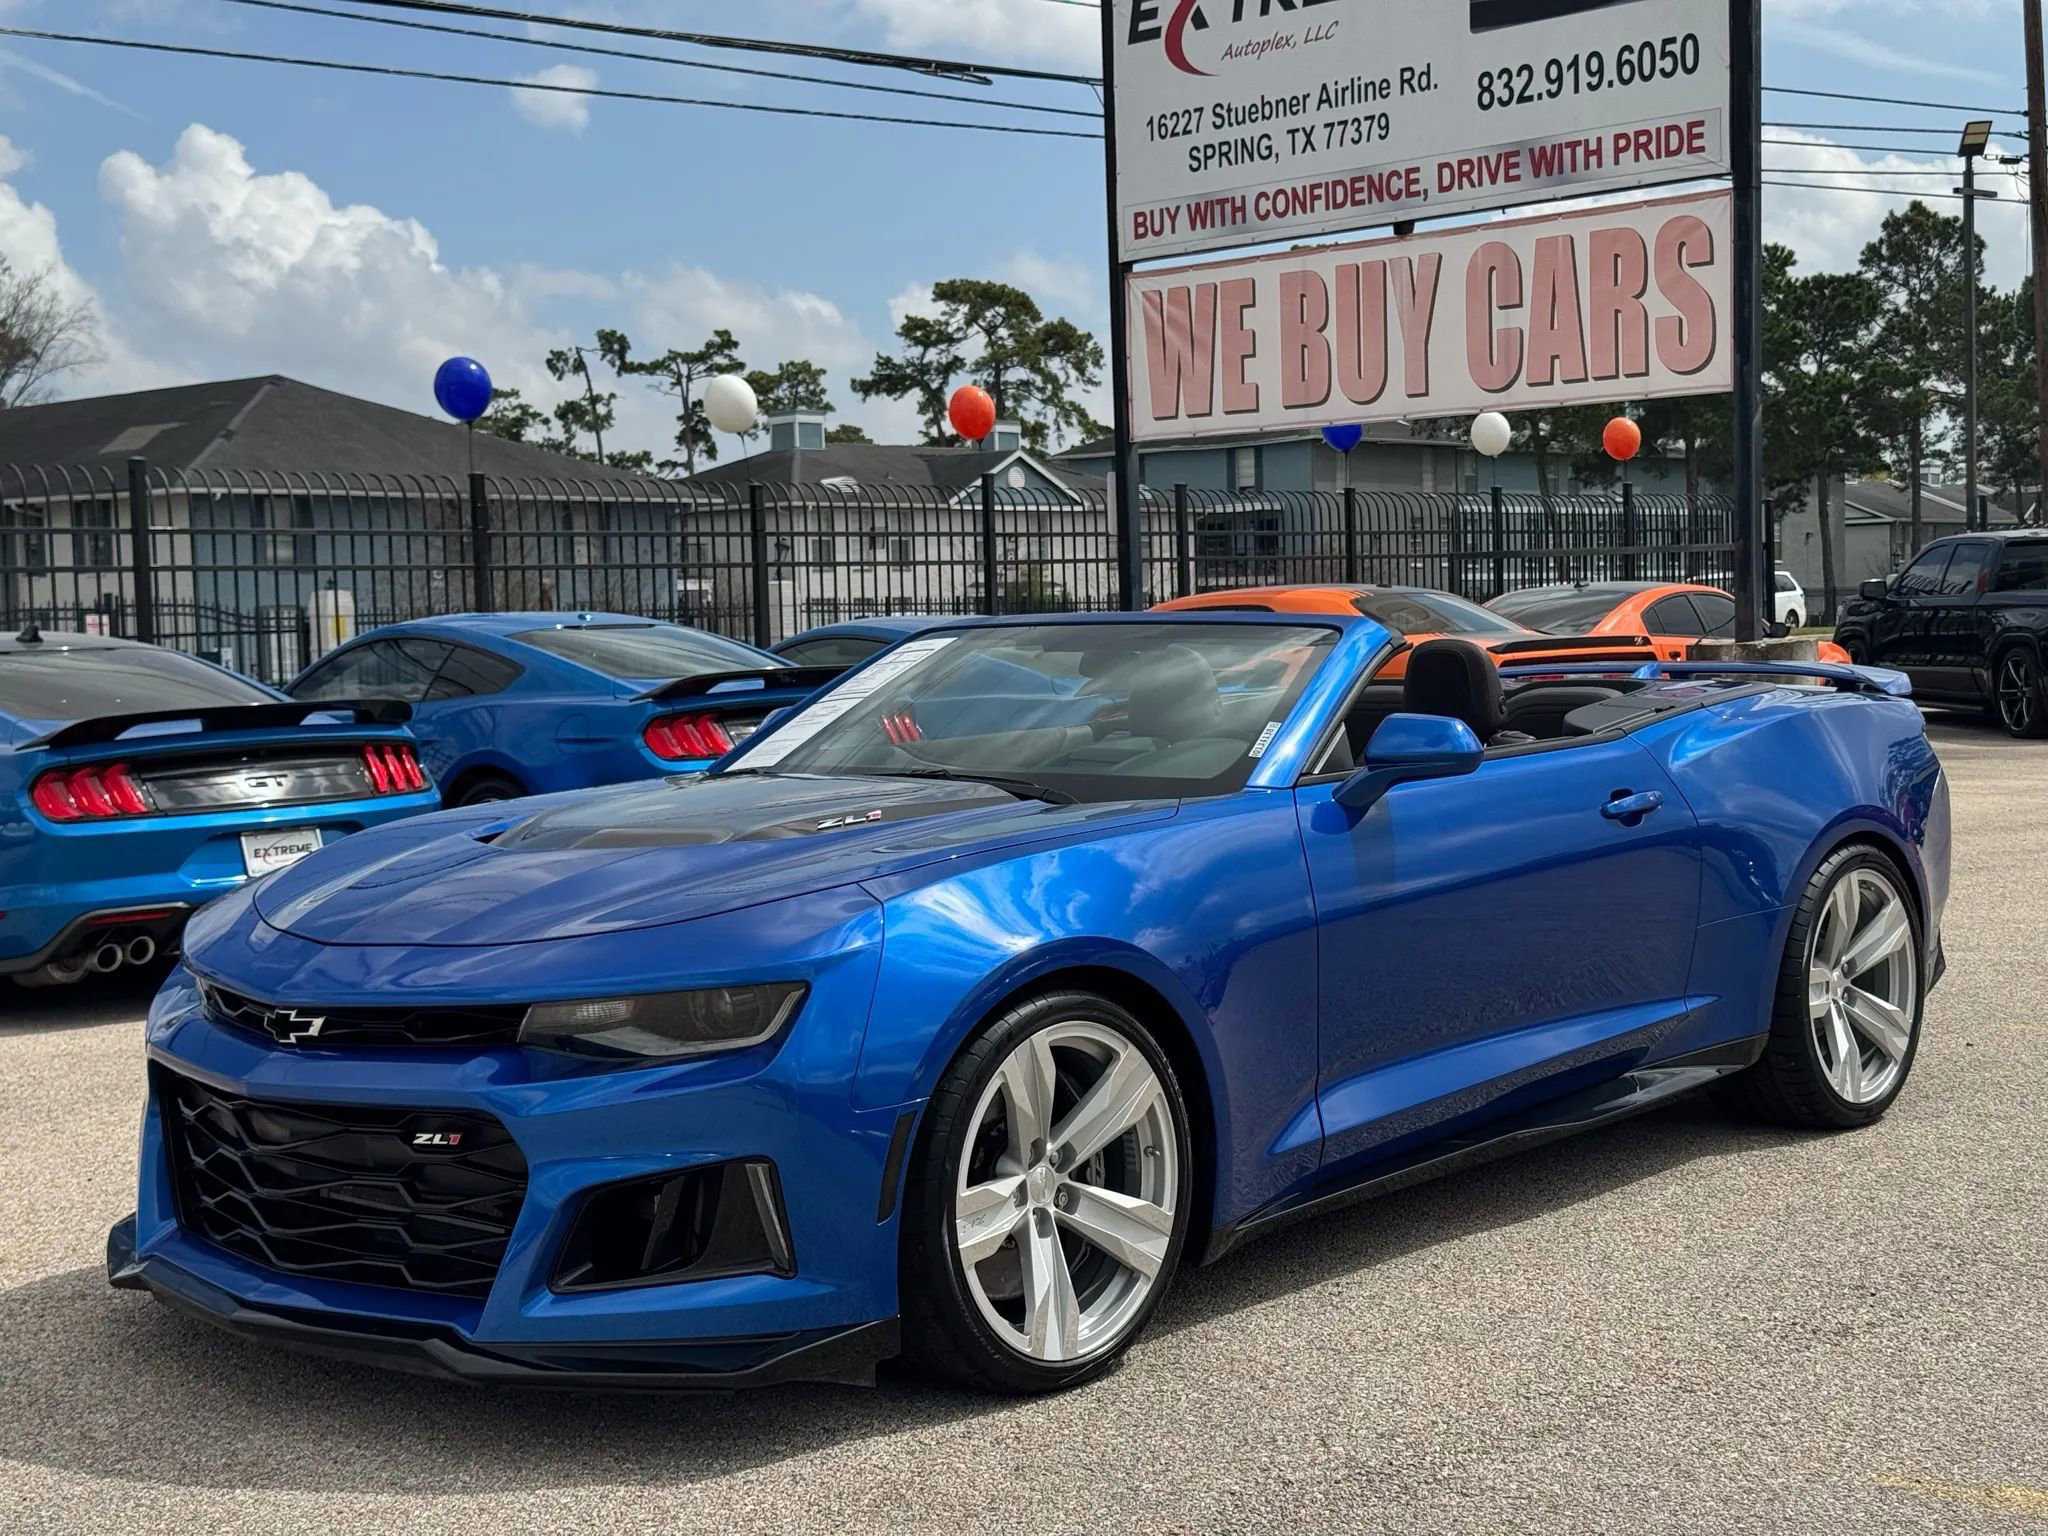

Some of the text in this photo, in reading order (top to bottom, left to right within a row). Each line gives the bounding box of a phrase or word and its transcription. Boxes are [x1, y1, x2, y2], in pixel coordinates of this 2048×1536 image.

[1220, 20, 1340, 61] Autoplex, LLC
[1477, 33, 1700, 111] 832.919.6050
[1146, 62, 1438, 142] 16227 Stuebner Airline Rd.
[1188, 112, 1390, 173] SPRING, TX 77379
[1133, 120, 1706, 240] BUY WITH CONFIDENCE, DRIVE WITH PRIDE
[1142, 216, 1717, 421] WE BUY CARS
[244, 774, 288, 788] GT
[816, 810, 882, 831] ZL1
[254, 843, 313, 858] EXTREME
[413, 1133, 462, 1145] ZL1
